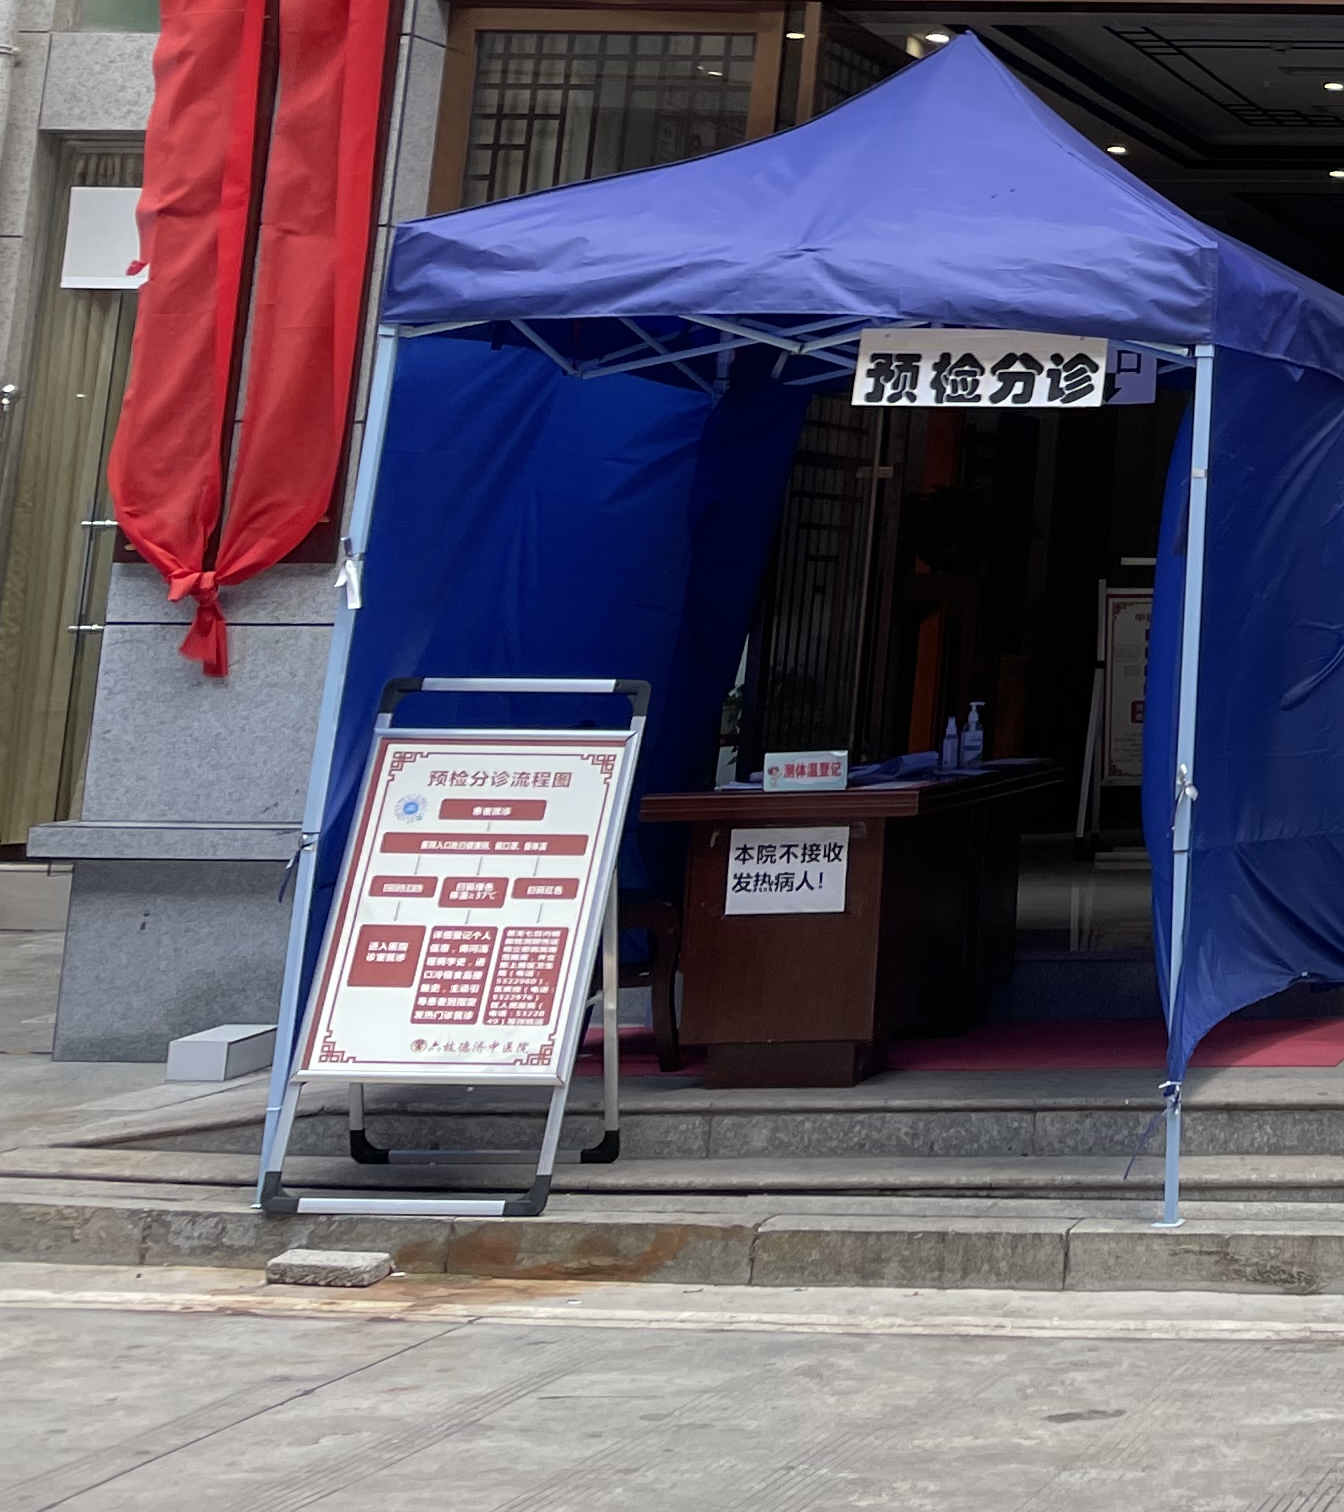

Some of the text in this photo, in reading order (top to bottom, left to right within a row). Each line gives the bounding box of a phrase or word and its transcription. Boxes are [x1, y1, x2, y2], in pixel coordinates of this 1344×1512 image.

[864, 351, 1100, 405] 预检分诊
[427, 770, 573, 788] 预检分诊流程图
[783, 761, 842, 779] 测体温登记
[734, 841, 845, 865] 本院不接收
